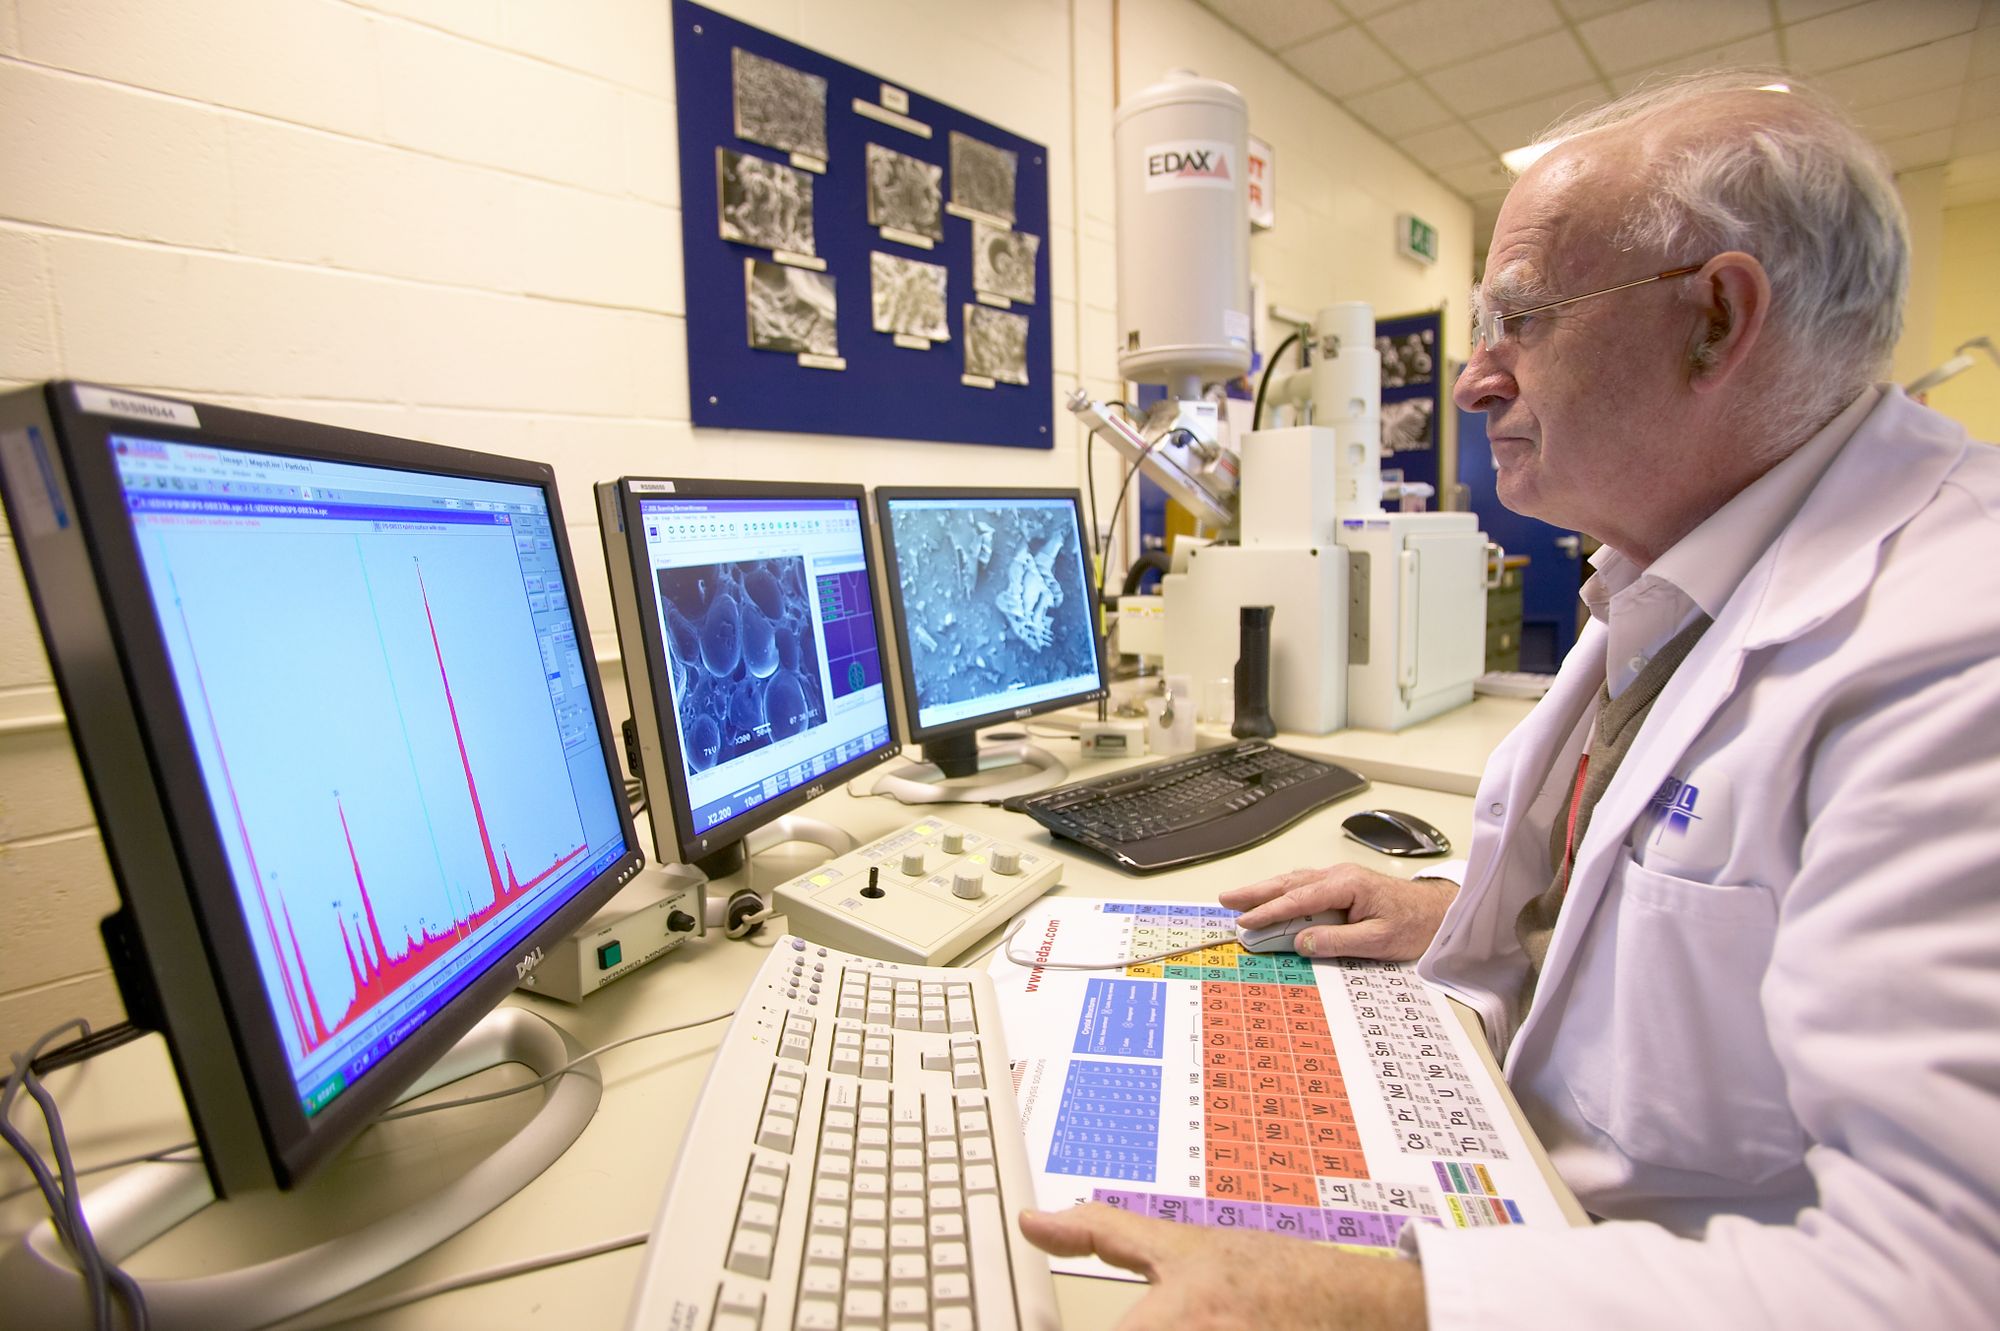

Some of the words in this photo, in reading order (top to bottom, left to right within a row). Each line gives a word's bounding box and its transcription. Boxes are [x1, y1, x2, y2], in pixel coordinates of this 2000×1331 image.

[1148, 150, 1211, 176] EDAX
[222, 455, 244, 466] Image
[284, 462, 311, 472] Particles
[735, 733, 751, 745] X300
[599, 959, 641, 986] INFRARED
[644, 935, 687, 961] MINISCOPE
[1025, 919, 1061, 993] wwwedax.com
[515, 946, 545, 980] DELL
[1208, 968, 1222, 979] Ga
[1350, 975, 1365, 986] Dy
[1209, 983, 1222, 994] Zn
[1248, 985, 1261, 997] Cd
[1289, 987, 1304, 998] Hg
[1356, 990, 1368, 1001] Tb
[1397, 991, 1411, 1003] Bk
[1209, 999, 1223, 1011] Cu
[1251, 1001, 1267, 1012] Ag
[1292, 1003, 1306, 1015] Au
[1361, 1006, 1376, 1018] Gd
[1404, 1007, 1419, 1021] Cm
[1210, 1016, 1224, 1026] Ni
[1252, 1017, 1266, 1029] Pd
[1295, 1021, 1309, 1031] Pt
[1368, 1024, 1383, 1036] Eu
[1413, 1024, 1426, 1039] Am
[1211, 1033, 1225, 1046] Co
[1255, 1036, 1269, 1048] Rh
[1300, 1041, 1313, 1049] Ir
[1375, 1041, 1390, 1057] Sm
[1420, 1044, 1435, 1057] Pu
[1212, 1053, 1226, 1065] Fe
[1258, 1055, 1272, 1068] Ru
[1303, 1057, 1317, 1072] Os
[1382, 1061, 1398, 1078] Pm
[1429, 1064, 1446, 1079] Np
[1189, 1072, 1199, 1084] VIIB
[1212, 1072, 1227, 1087] Mn
[1260, 1076, 1274, 1089] Tc
[1309, 1079, 1323, 1094] Re
[1390, 1084, 1407, 1099] Nd
[1439, 1089, 1454, 1098] U
[1189, 1095, 1199, 1106] VIB
[1213, 1096, 1229, 1110] Cr
[1263, 1097, 1278, 1115] Mo
[1312, 1103, 1329, 1115] W
[1397, 1108, 1415, 1122] Pr
[1450, 1110, 1468, 1126] Pa
[1189, 1120, 1200, 1130] VB
[1214, 1123, 1230, 1132] V
[1265, 1123, 1282, 1140] Nb
[1318, 1127, 1333, 1142] Ta
[1407, 1133, 1425, 1150] Ce
[1459, 1136, 1479, 1152] Th
[1189, 1146, 1200, 1159] IVB
[1215, 1147, 1232, 1160] Ti
[1269, 1151, 1286, 1167] Zr
[1323, 1155, 1341, 1170] Hf
[1189, 1175, 1200, 1188] IIIB
[1216, 1175, 1233, 1193] Sc
[1272, 1184, 1290, 1193] Y
[1331, 1184, 1349, 1203] La
[1389, 1188, 1408, 1208] Ac
[1450, 1197, 1459, 1211] Earth
[1217, 1206, 1236, 1227] Ca
[1276, 1212, 1296, 1231] Sr
[1337, 1216, 1357, 1238] Ba
